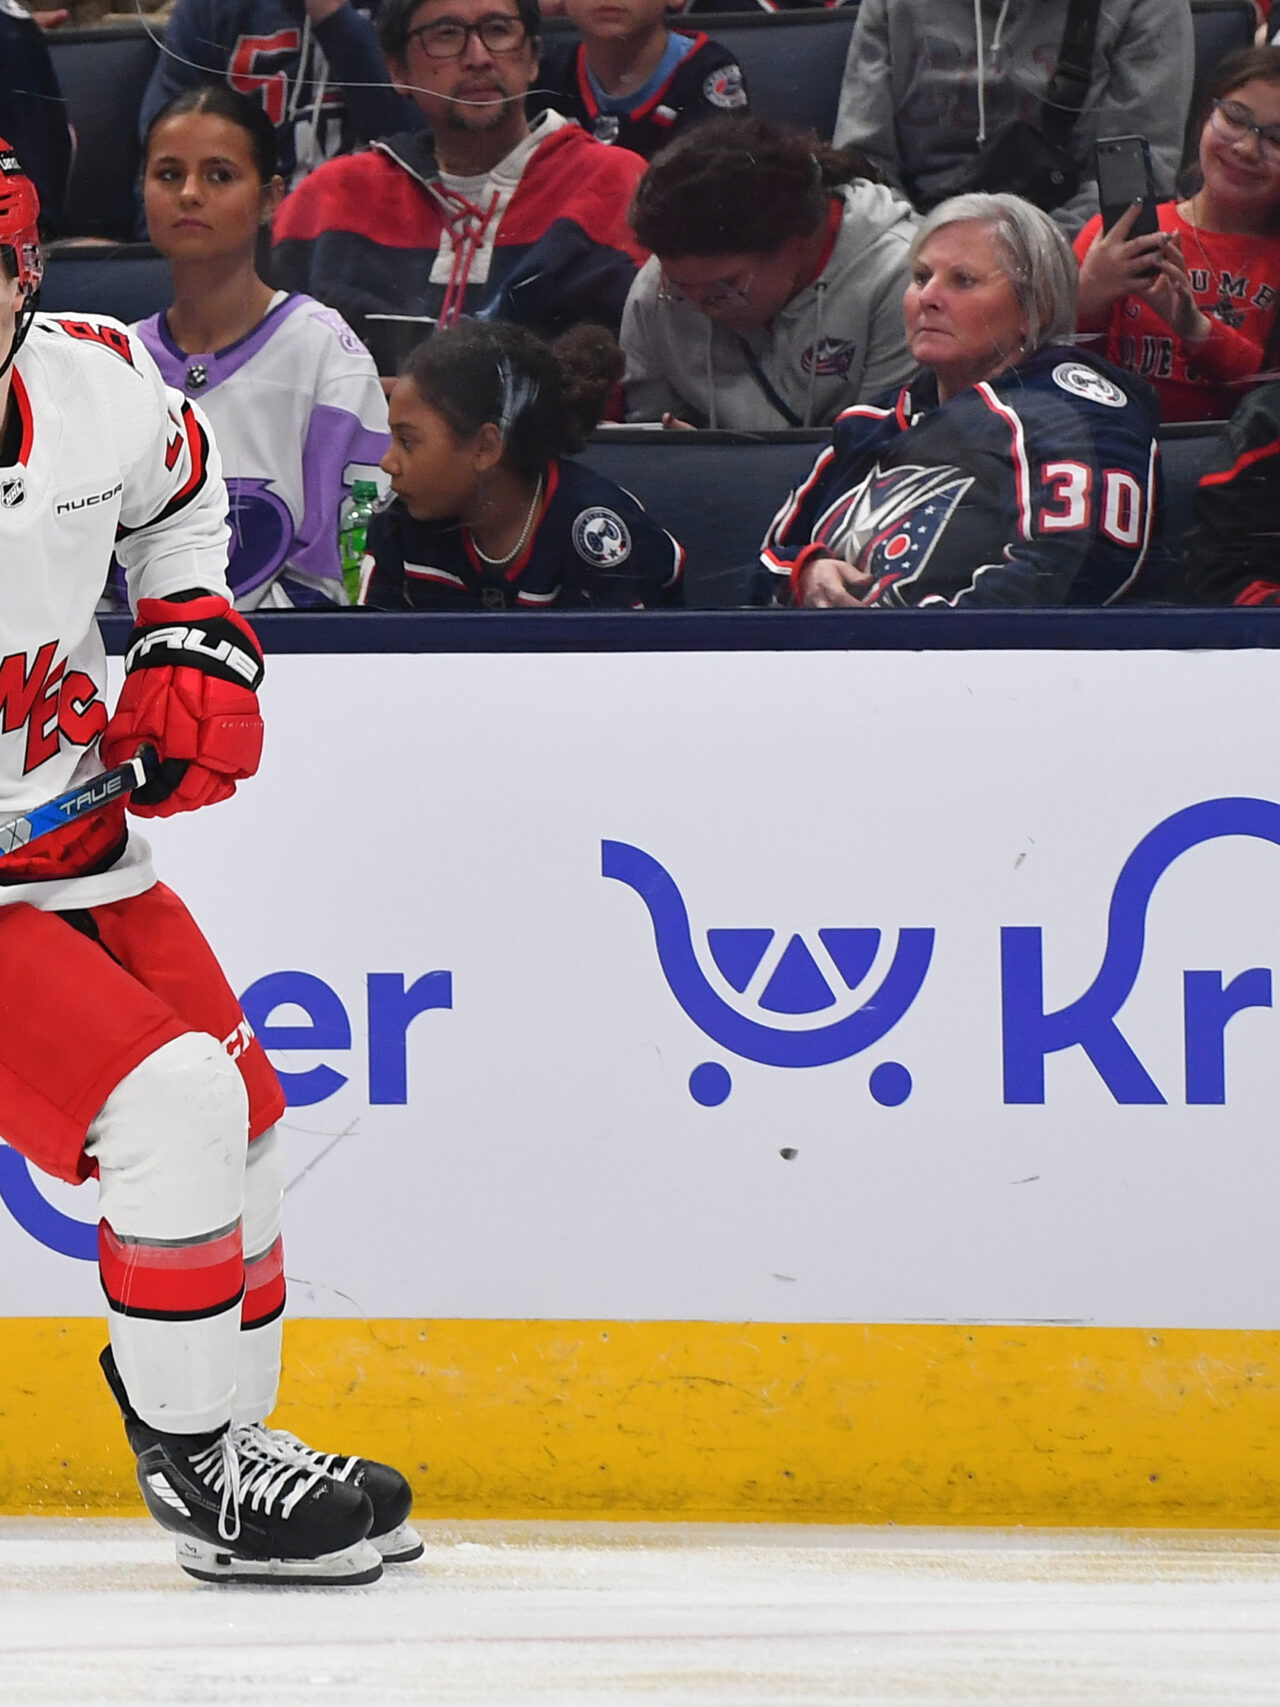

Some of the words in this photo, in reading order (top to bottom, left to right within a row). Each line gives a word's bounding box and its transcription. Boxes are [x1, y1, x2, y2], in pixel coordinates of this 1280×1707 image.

[57, 483, 123, 515] NUCOR
[1039, 459, 1144, 549] 30
[59, 776, 122, 815] TRUE
